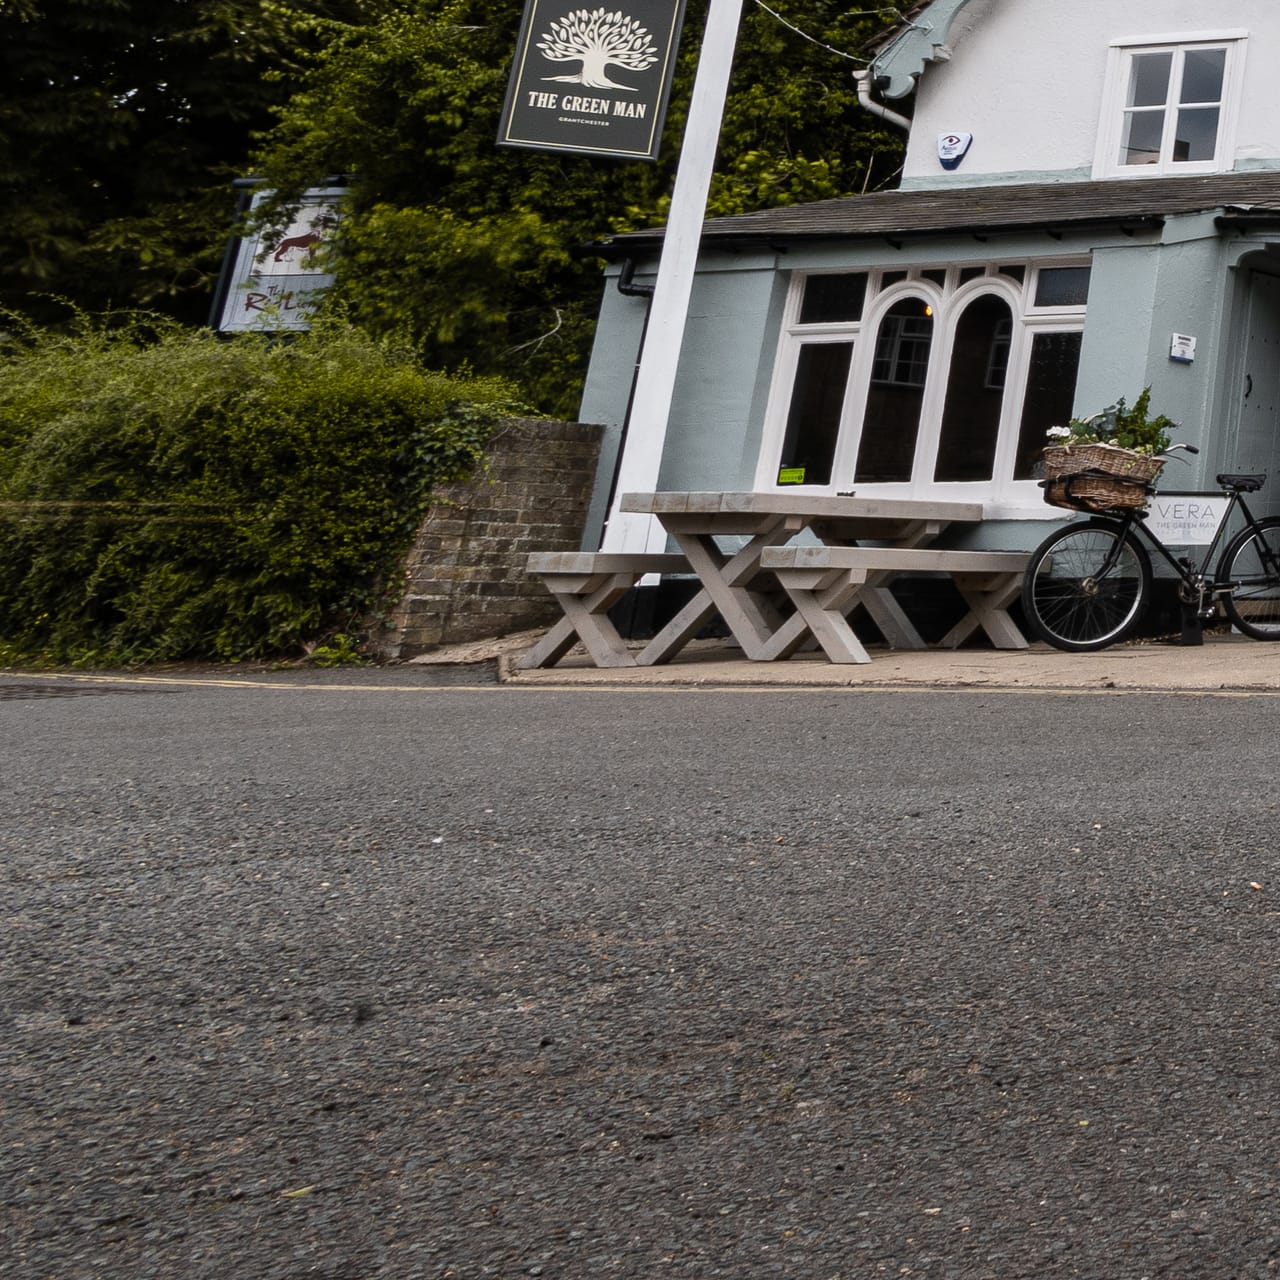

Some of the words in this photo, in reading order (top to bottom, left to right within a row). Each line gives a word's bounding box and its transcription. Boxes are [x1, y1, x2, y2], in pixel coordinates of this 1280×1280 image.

[528, 91, 558, 109] THE
[561, 95, 610, 114] GREEN
[612, 101, 647, 118] MAN
[558, 116, 610, 126] GRANTCHESTER
[1157, 503, 1215, 519] VERA
